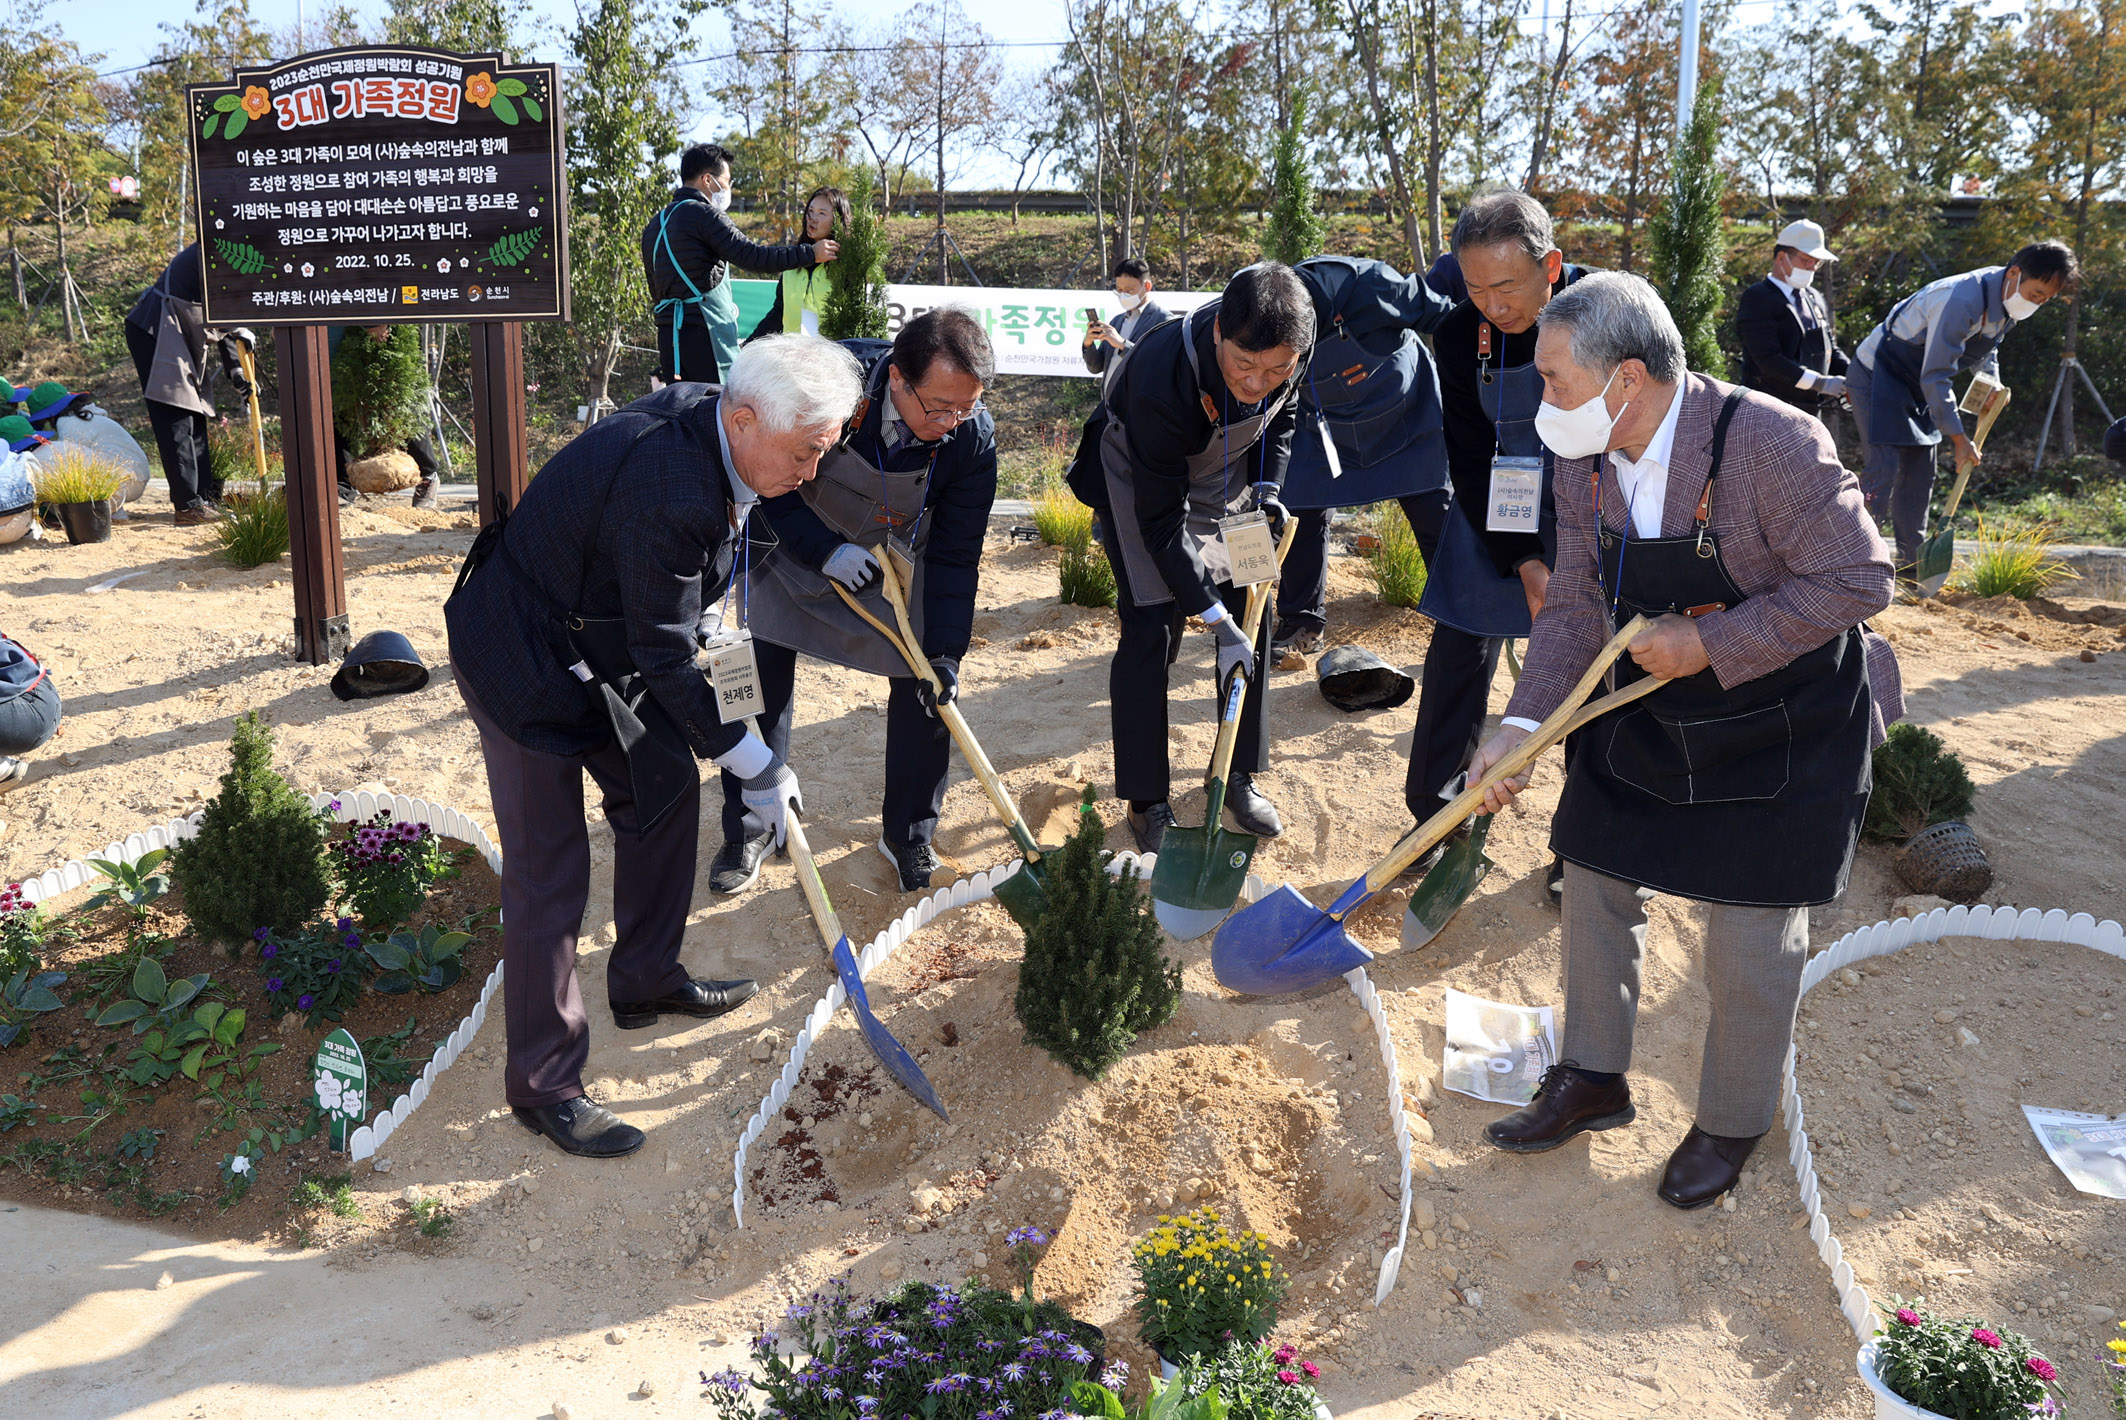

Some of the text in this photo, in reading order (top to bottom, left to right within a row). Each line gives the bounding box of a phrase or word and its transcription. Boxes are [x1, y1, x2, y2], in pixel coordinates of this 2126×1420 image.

[269, 58, 463, 91] 2023순천만국제정원박람회 성공기원
[273, 76, 461, 130] 3대 가족정원
[237, 137, 508, 166] 이 숲은 3대 가족이 모여 (사)숲속의전남과 함께
[249, 166, 498, 193] 조성한 정원으로 참여 가족의 행복과 희망을
[233, 193, 519, 220] 기원하는 마음을 담아 대대손손 아름답고 풍요로운
[278, 222, 471, 245] 정원으로 가꾸어 나가고자 합니다.
[336, 254, 414, 268] 2022. 10. 25.
[252, 290, 306, 306] 주관/후원:
[310, 288, 388, 306] (사)숲속의전남
[421, 288, 459, 300] 전라남도
[1497, 504, 1532, 518] 황금영
[1238, 554, 1269, 570] 서동욱
[723, 683, 754, 705] 천제영
